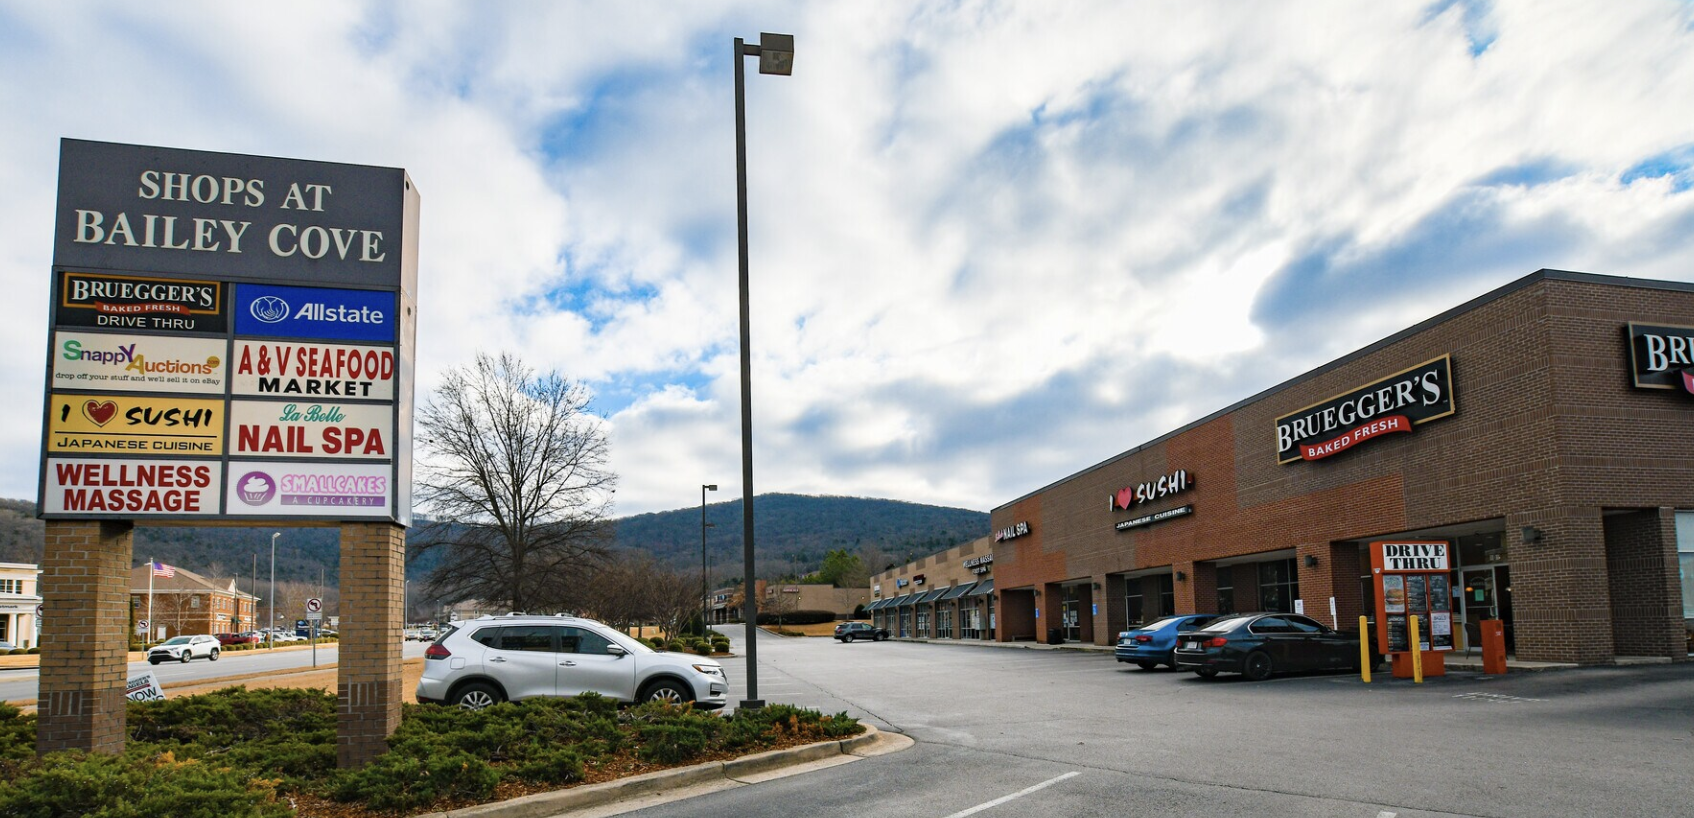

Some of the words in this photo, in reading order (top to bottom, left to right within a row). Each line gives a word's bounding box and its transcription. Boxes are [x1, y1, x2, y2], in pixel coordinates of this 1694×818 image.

[139, 170, 265, 208] SHOPS
[280, 182, 332, 212] AT
[74, 209, 252, 253] BAILEY
[268, 223, 386, 263] COVE
[72, 279, 213, 307] BRUEGGER'S
[102, 304, 141, 313] BAKED
[145, 304, 180, 312] FRESH
[294, 302, 384, 325] Allstate
[97, 315, 147, 328] DRIVE
[151, 318, 195, 330] THRU
[238, 345, 253, 375] A
[257, 345, 272, 375] &
[274, 346, 292, 376] V
[296, 347, 394, 381] SEAFOOD
[55, 371, 74, 380] drop
[89, 373, 109, 381] your
[202, 377, 221, 385] eBay
[258, 377, 373, 397] MARKET
[61, 404, 71, 422] I
[125, 406, 213, 427] SUSHI
[278, 403, 302, 422] La
[303, 404, 347, 424] Belle
[1277, 368, 1441, 453] BRUEGGER'S
[57, 436, 149, 451] JAPANESE
[151, 438, 214, 452] CUISINE
[237, 424, 314, 455] NAIL
[321, 426, 386, 456] SPA
[1308, 436, 1350, 458] BAKED
[1354, 418, 1399, 441] FRESH
[57, 463, 211, 488] WELLNESS
[280, 474, 386, 494] SMALLCAKES
[63, 489, 201, 512] MASSAGE
[307, 497, 374, 506] CUPCAKERY
[1109, 493, 1115, 512] I
[1137, 469, 1187, 504] SUSHI
[1115, 516, 1151, 529] JAPANESE
[1154, 506, 1187, 520] CUISINE
[1003, 525, 1016, 541] NAIL
[1016, 521, 1029, 536] SPA
[1385, 544, 1445, 557] DRIVE
[1389, 557, 1441, 570] THRU
[126, 686, 157, 701] NOW
